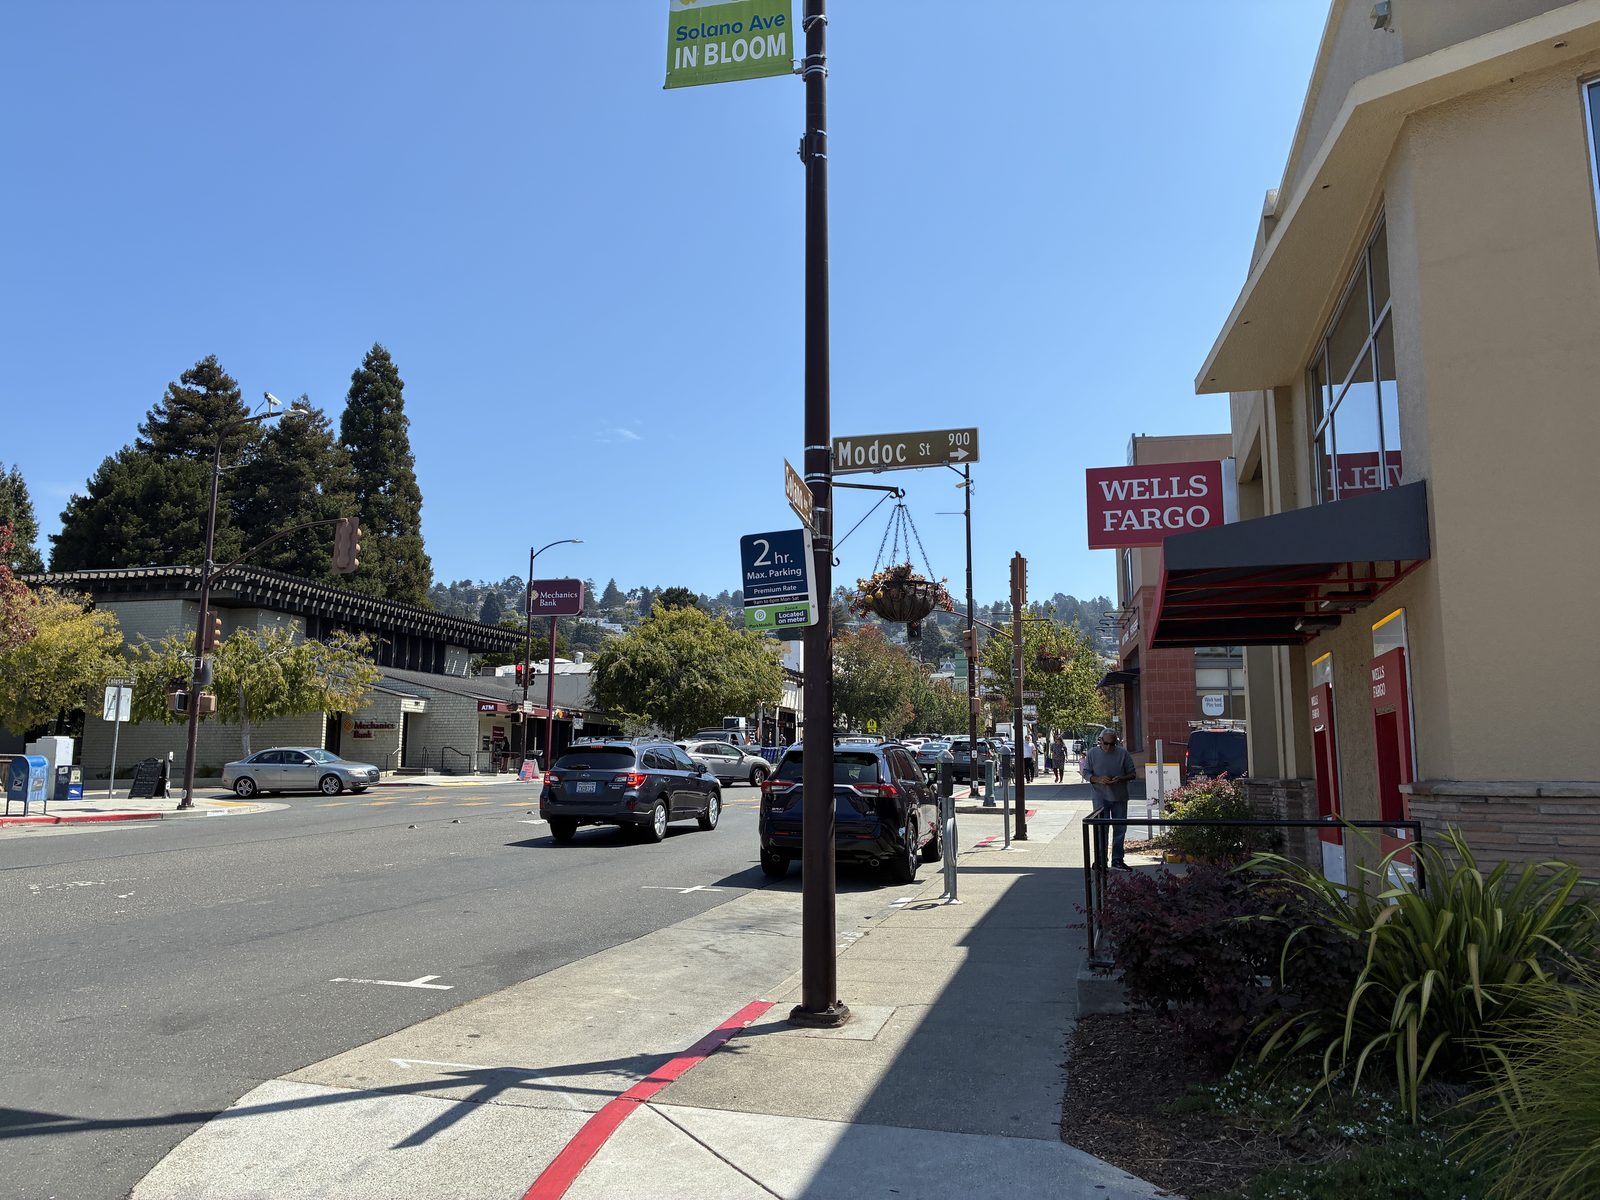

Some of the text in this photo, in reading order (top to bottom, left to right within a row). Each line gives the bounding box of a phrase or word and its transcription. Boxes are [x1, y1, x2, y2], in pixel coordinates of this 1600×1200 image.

[676, 14, 786, 42] Solano Ave
[674, 32, 786, 70] IN BLOOM
[838, 432, 970, 466] Modoc St 900
[1098, 474, 1208, 502] WELLS
[1102, 506, 1210, 532] FARGO
[752, 539, 793, 566] 2 hr.
[746, 568, 802, 580] Max. Parking
[754, 586, 782, 594] Premium
[1371, 665, 1385, 681] WELLS
[1372, 682, 1386, 698] FARGO
[353, 730, 373, 738] Bank
[354, 720, 396, 729] Mechanics
